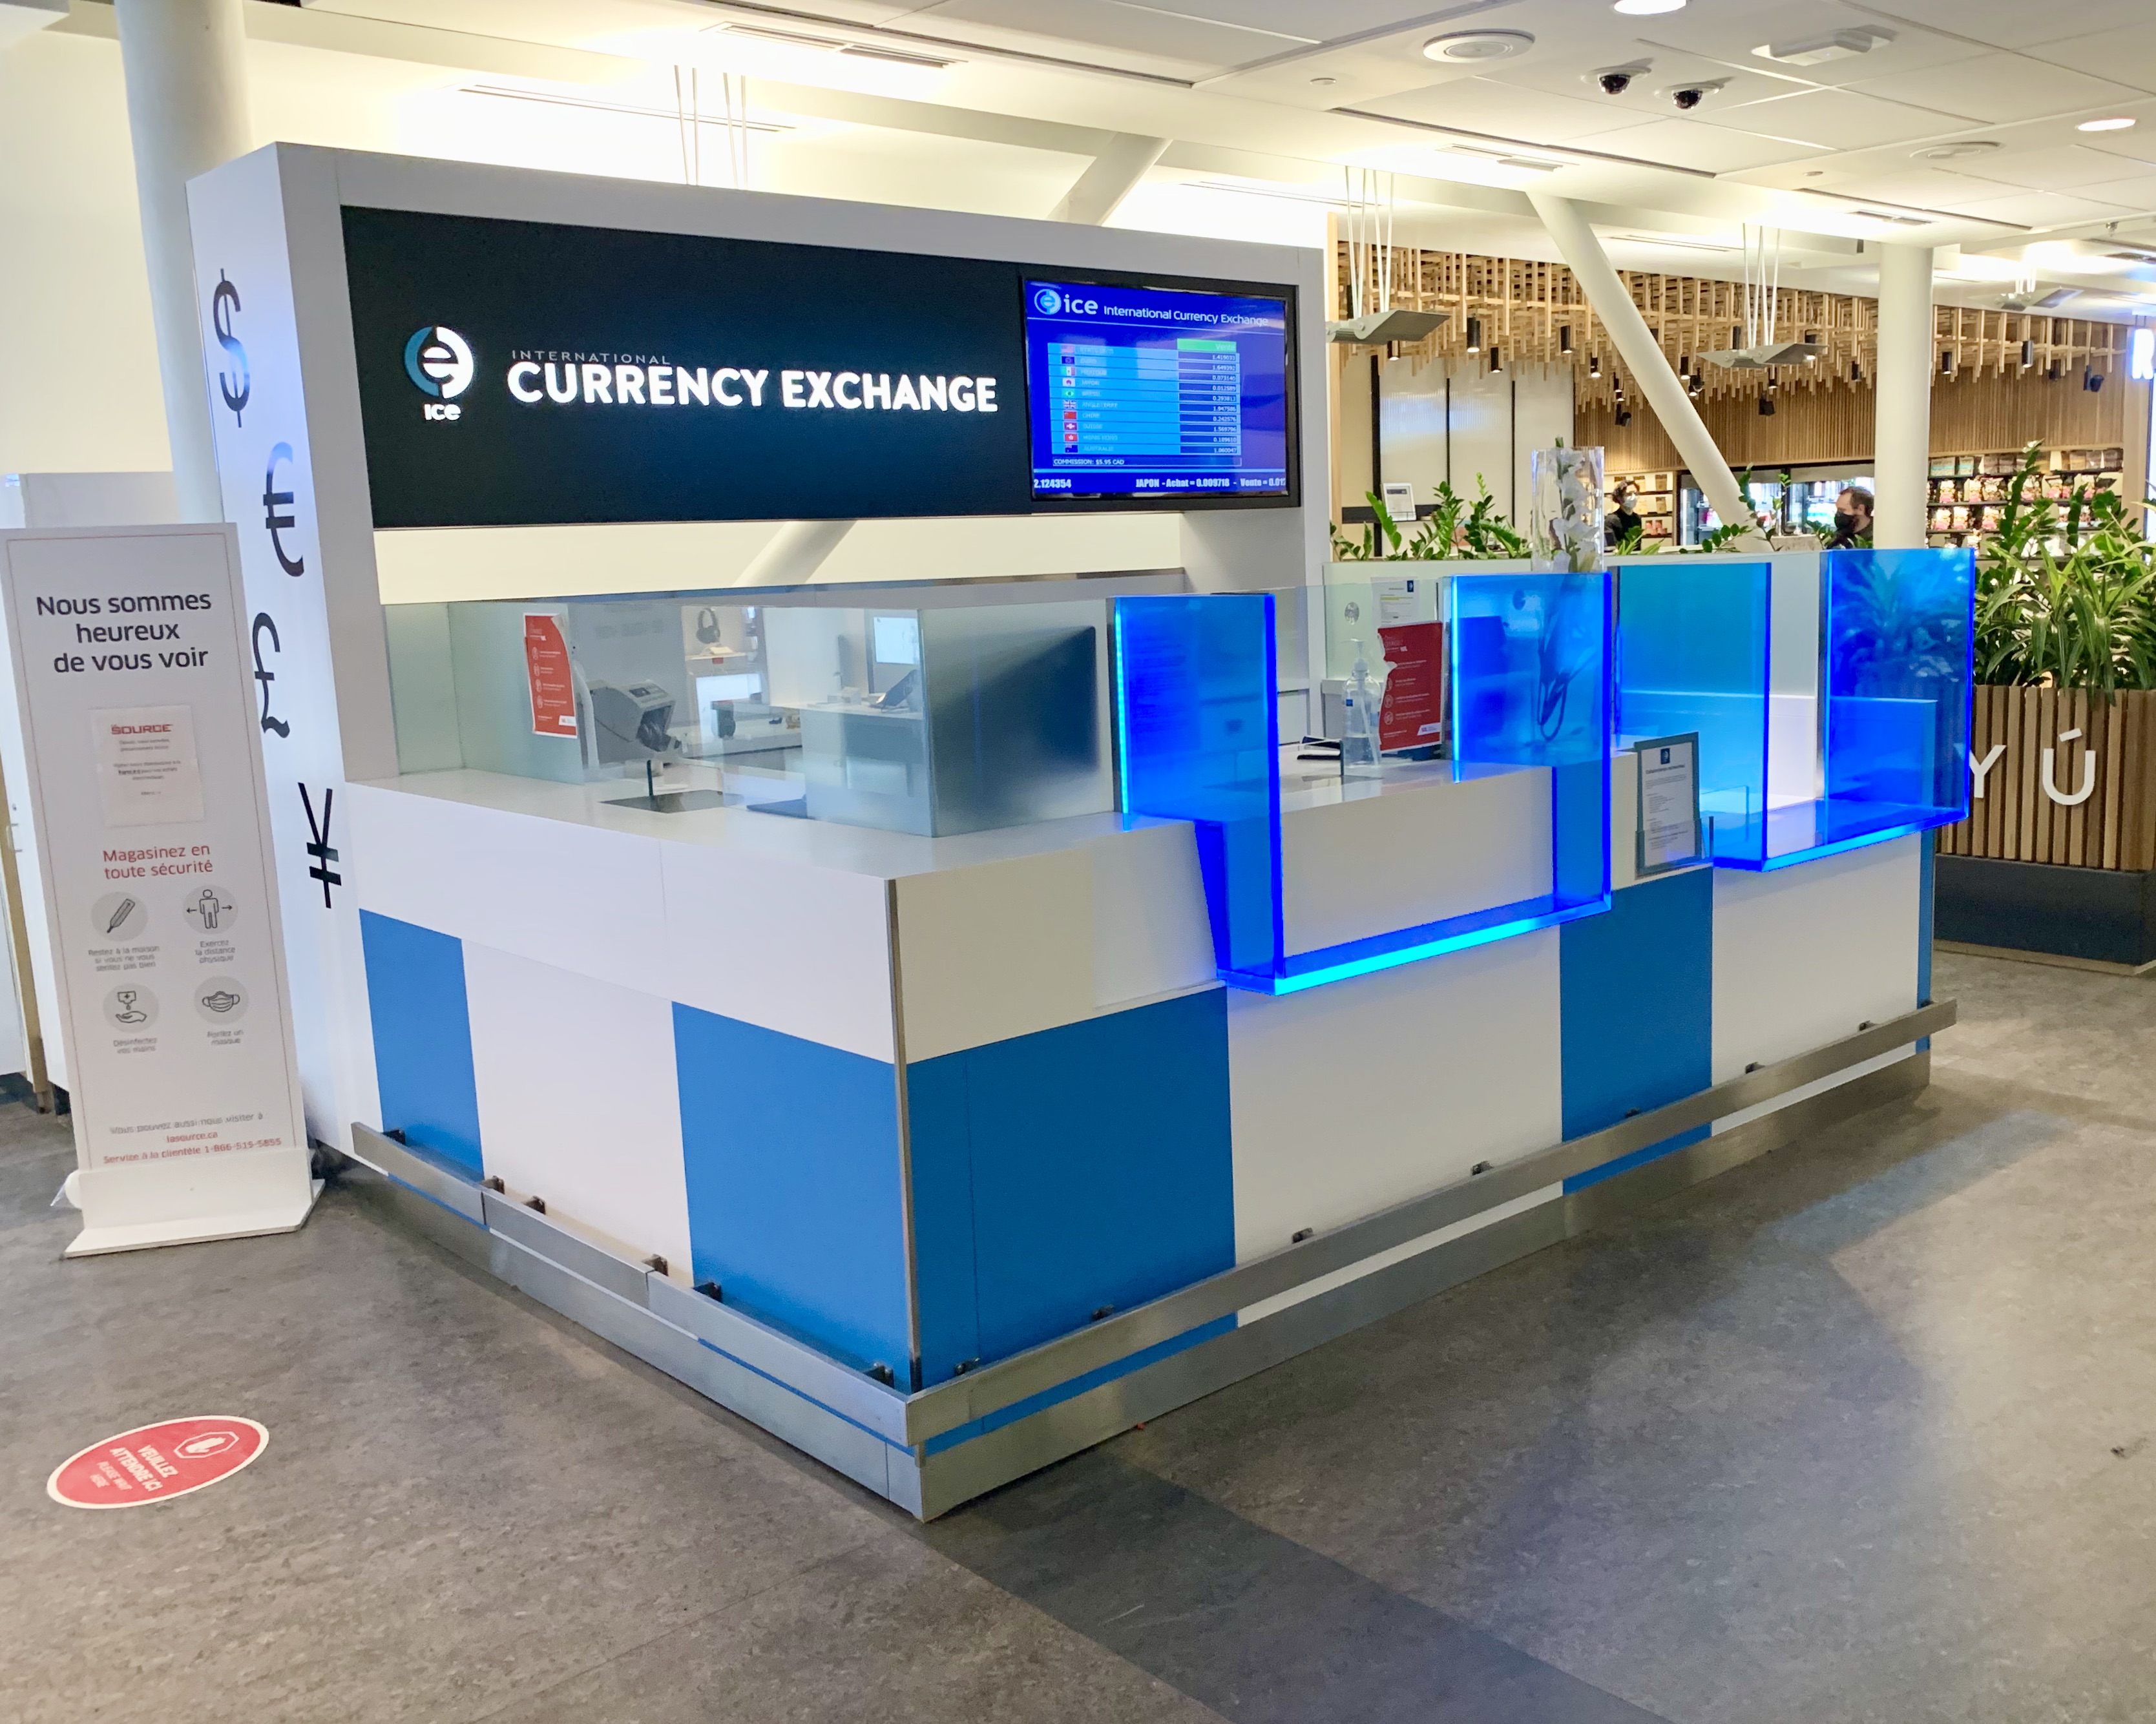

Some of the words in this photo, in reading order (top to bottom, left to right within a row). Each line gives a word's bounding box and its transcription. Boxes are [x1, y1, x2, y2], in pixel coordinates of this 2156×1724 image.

[1063, 293, 1098, 315] ice
[1104, 306, 1171, 320] International
[1173, 311, 1218, 324] Currency
[1220, 314, 1268, 327] Exchange
[213, 268, 250, 428] $
[512, 350, 670, 364] INTERNATIONAL
[507, 362, 769, 407] CURRENCY
[782, 369, 998, 413] EXCHANGE
[1136, 479, 1160, 488] JAPON
[1166, 479, 1189, 487] Achat
[1196, 478, 1230, 487] 0.009718
[1240, 479, 1261, 487] Vente
[262, 442, 304, 577] €
[36, 596, 101, 616] Nous
[108, 593, 212, 614] sommes
[76, 623, 180, 643] heureux
[54, 653, 85, 673] de
[92, 654, 152, 671] vous
[159, 647, 209, 669] voir
[252, 612, 290, 738] £
[111, 724, 173, 735] SOURCE
[103, 846, 186, 863] Magasinez
[191, 845, 211, 856] en
[298, 782, 341, 909] ¥
[105, 866, 145, 880] toute
[151, 860, 213, 876] sécurité
[204, 947, 235, 955] distance
[137, 1122, 171, 1133] pouvez
[174, 1119, 197, 1128] aussi
[198, 1117, 223, 1126] nous
[225, 1114, 255, 1123] visiter
[167, 1132, 218, 1143] lasource.ca
[103, 1154, 139, 1163] Service
[162, 1147, 201, 1158] clientèle
[109, 1447, 154, 1482] ATTENDRE
[141, 1478, 163, 1492] ICI
[137, 1444, 178, 1478] VEUILLEZ
